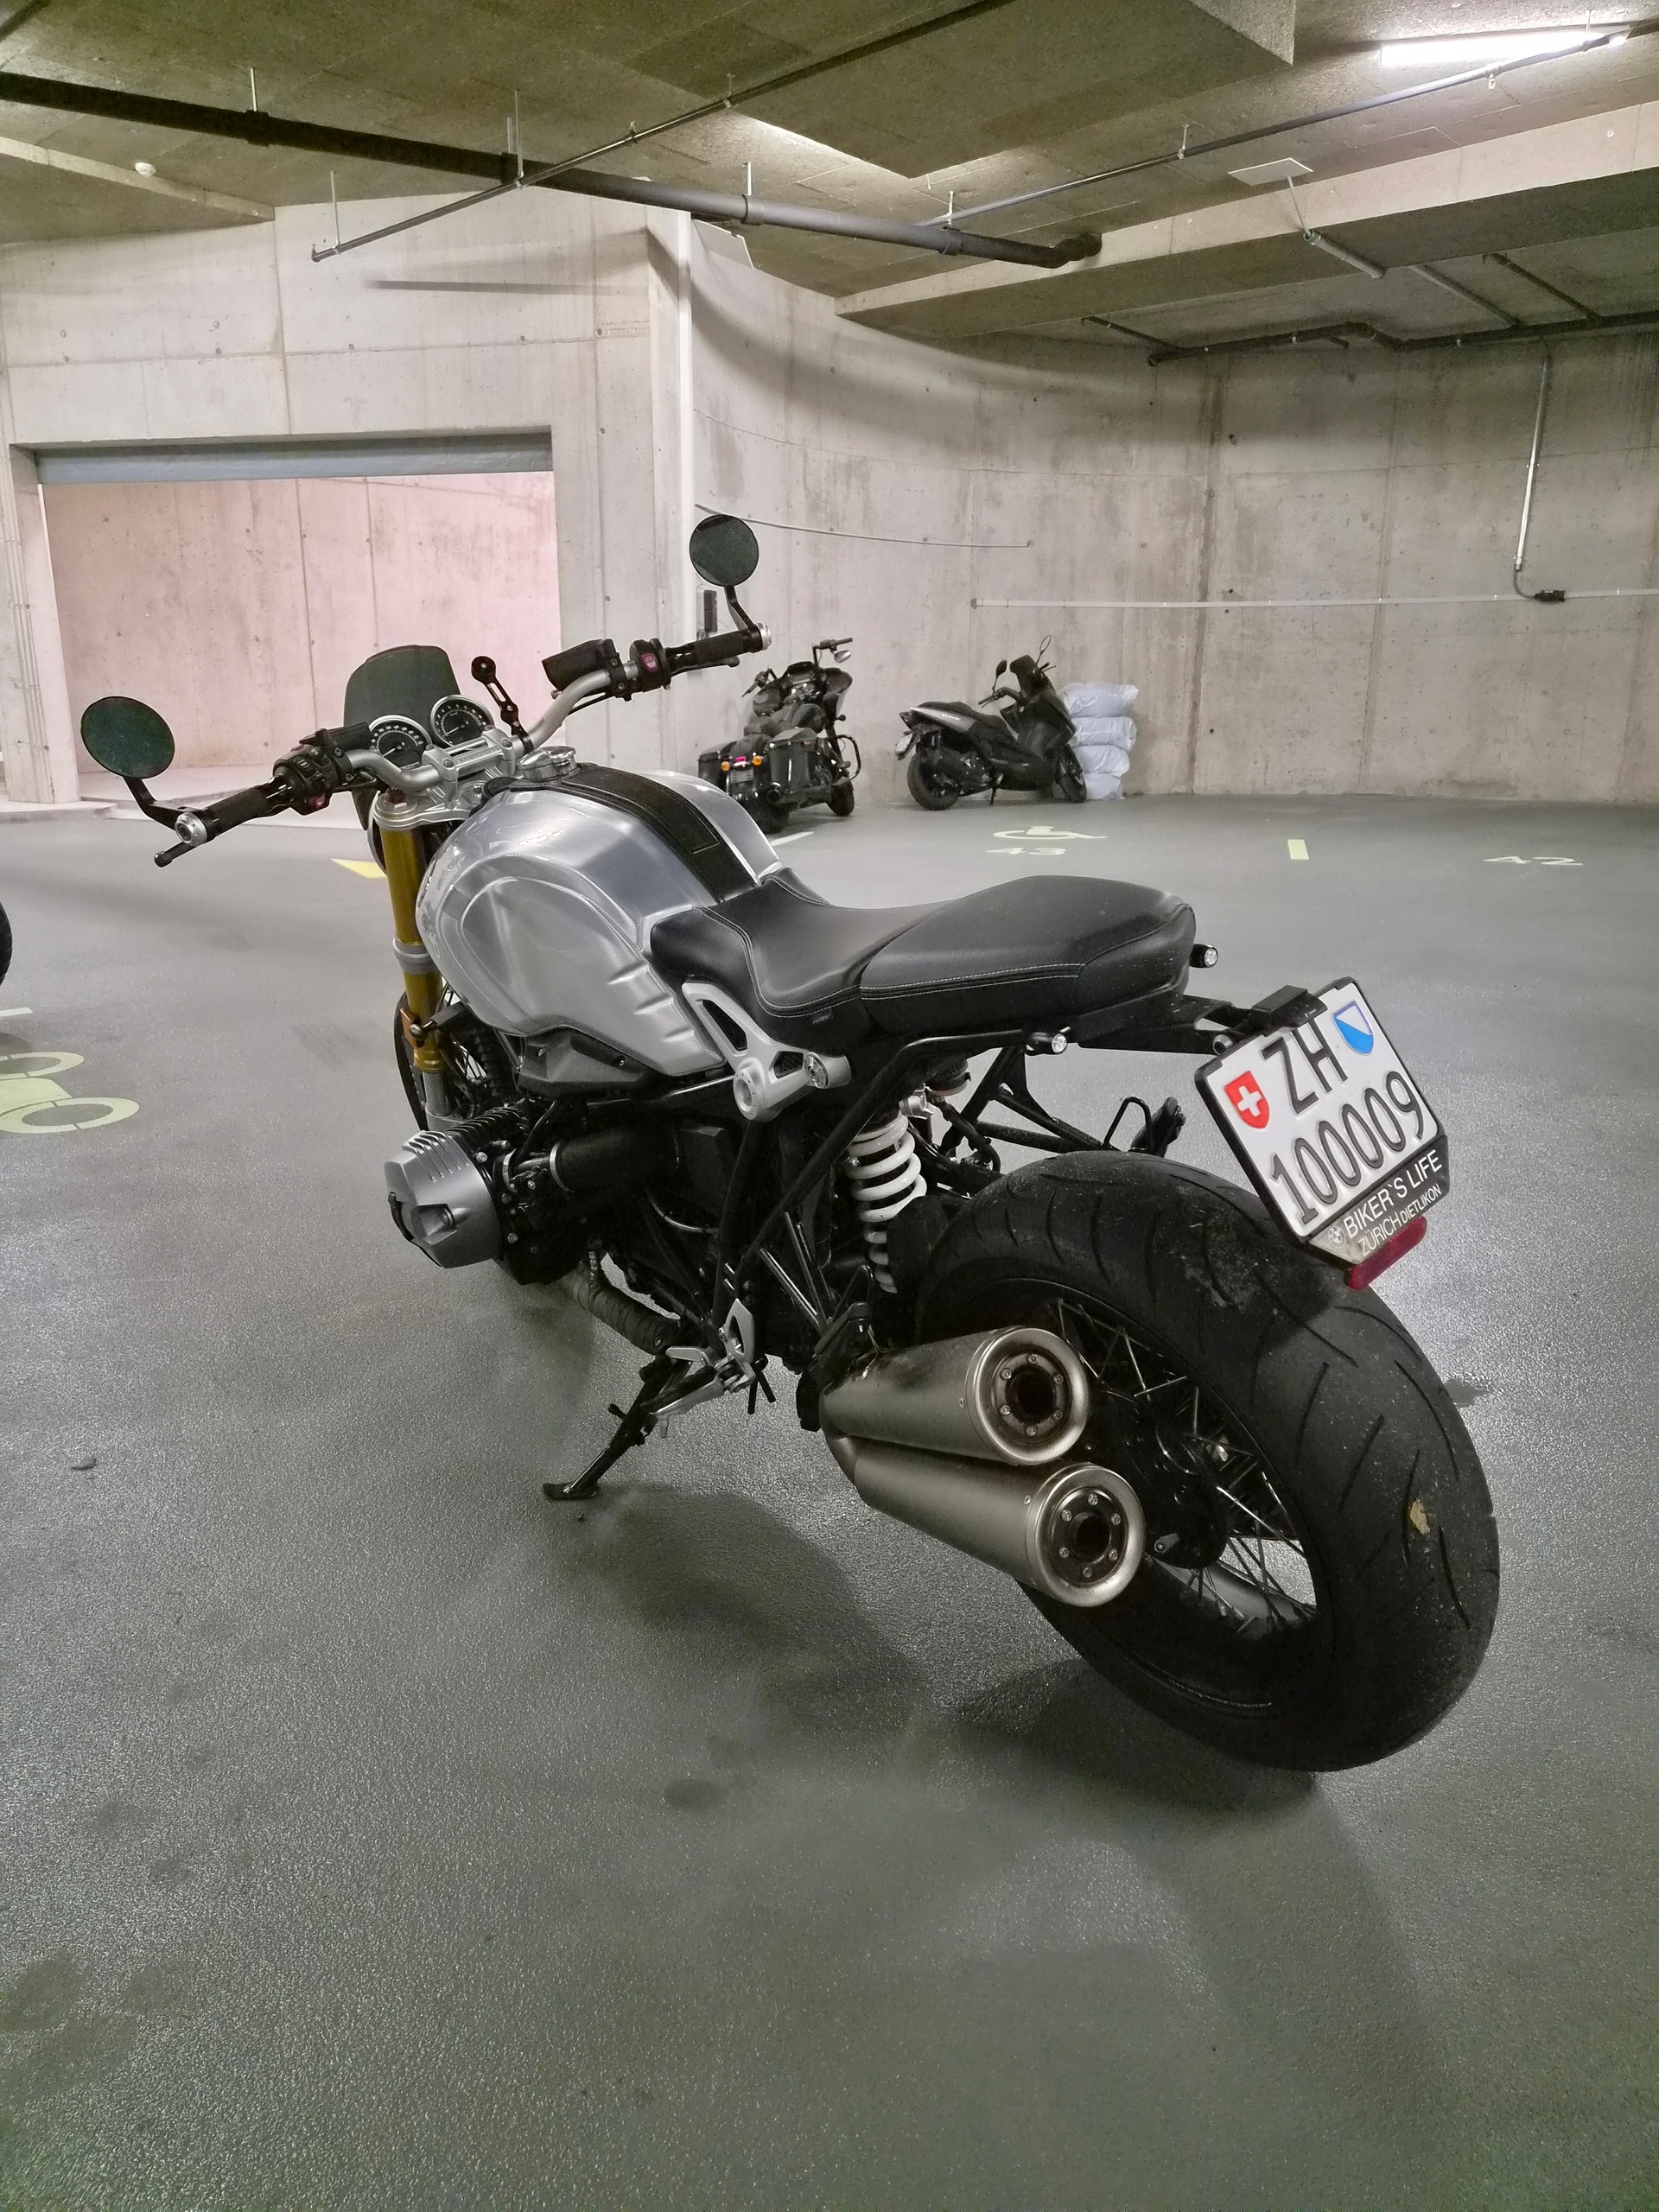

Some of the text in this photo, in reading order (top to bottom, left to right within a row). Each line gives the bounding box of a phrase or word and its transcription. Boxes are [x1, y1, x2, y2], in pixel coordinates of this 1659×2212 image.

[1484, 855, 1584, 866] 42
[1261, 1018, 1348, 1115] ZH
[1271, 1071, 1424, 1225] 100009
[1407, 1149, 1443, 1189] LIFE
[1357, 1211, 1402, 1256] ZÜRICH
[1400, 1183, 1442, 1224] DIETLIKON
